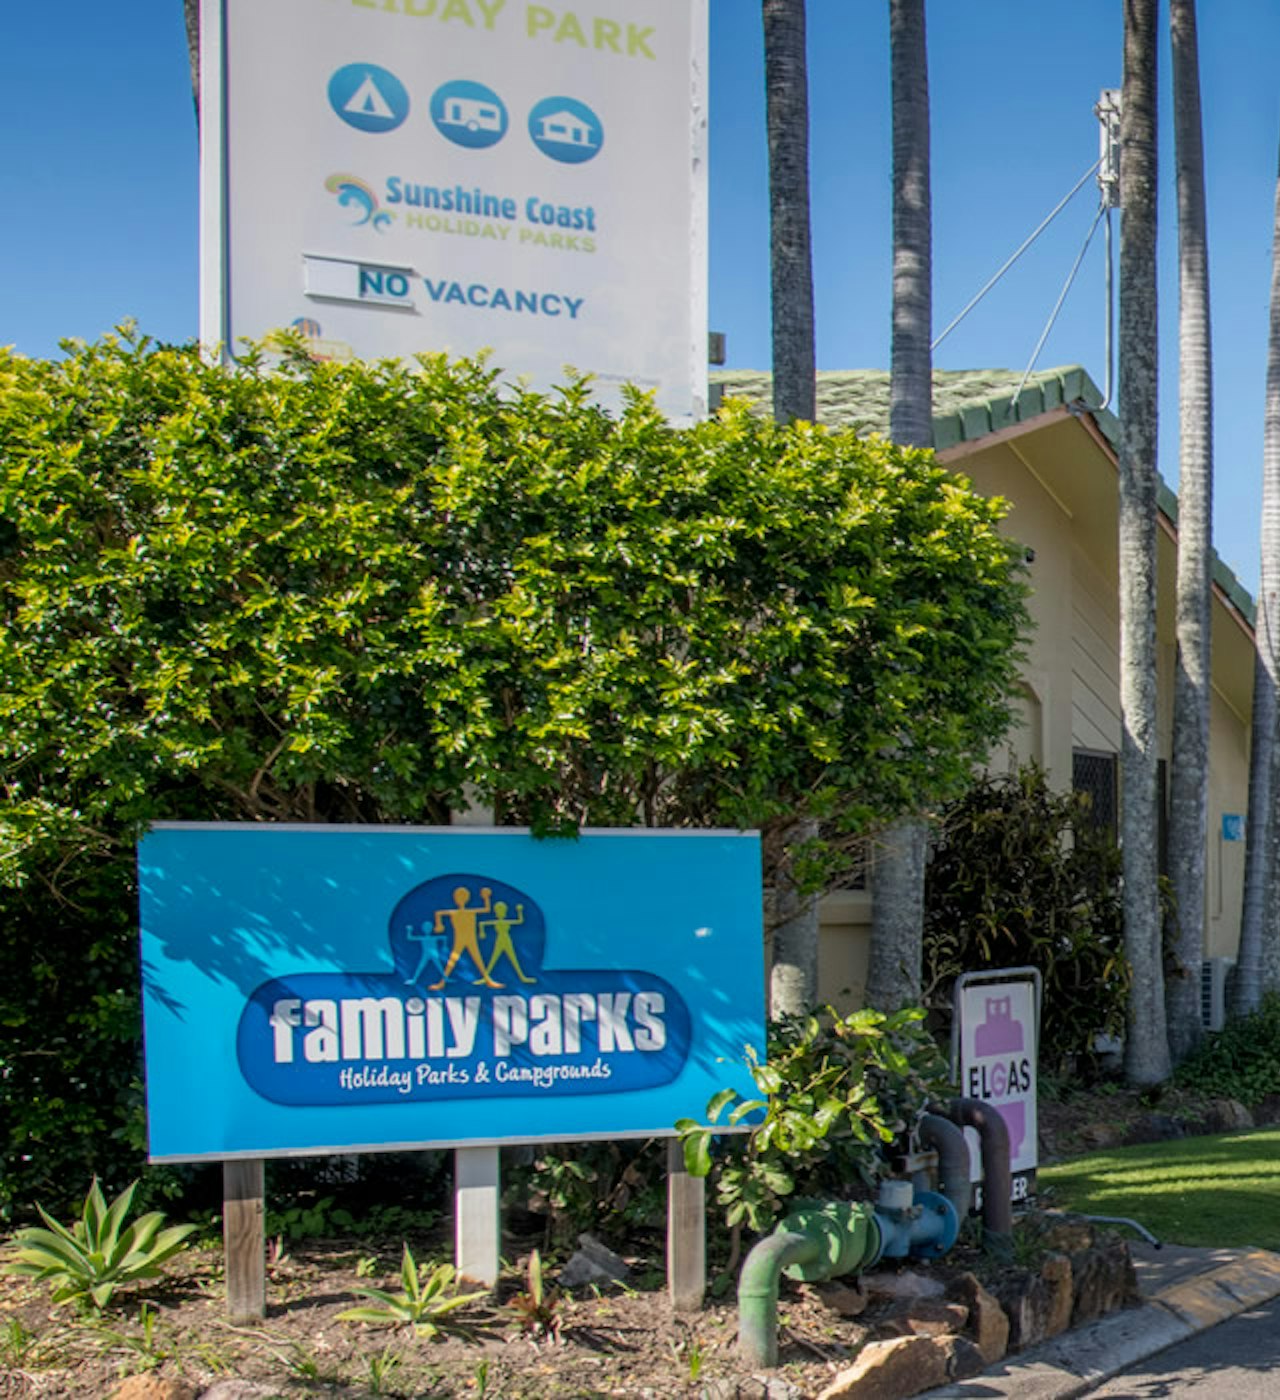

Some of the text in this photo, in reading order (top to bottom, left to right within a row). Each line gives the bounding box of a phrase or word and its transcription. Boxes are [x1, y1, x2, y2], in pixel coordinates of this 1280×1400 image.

[352, 0, 657, 61] DAY PARK
[386, 175, 597, 233] Sunshine Coast
[405, 211, 597, 253] HOLIDAY PARKS
[360, 270, 586, 320] NO VACANCY
[269, 991, 667, 1064] family parks
[339, 1057, 613, 1094] Holiday Parks & Campgrounds
[968, 1058, 1031, 1099] ELGAS
